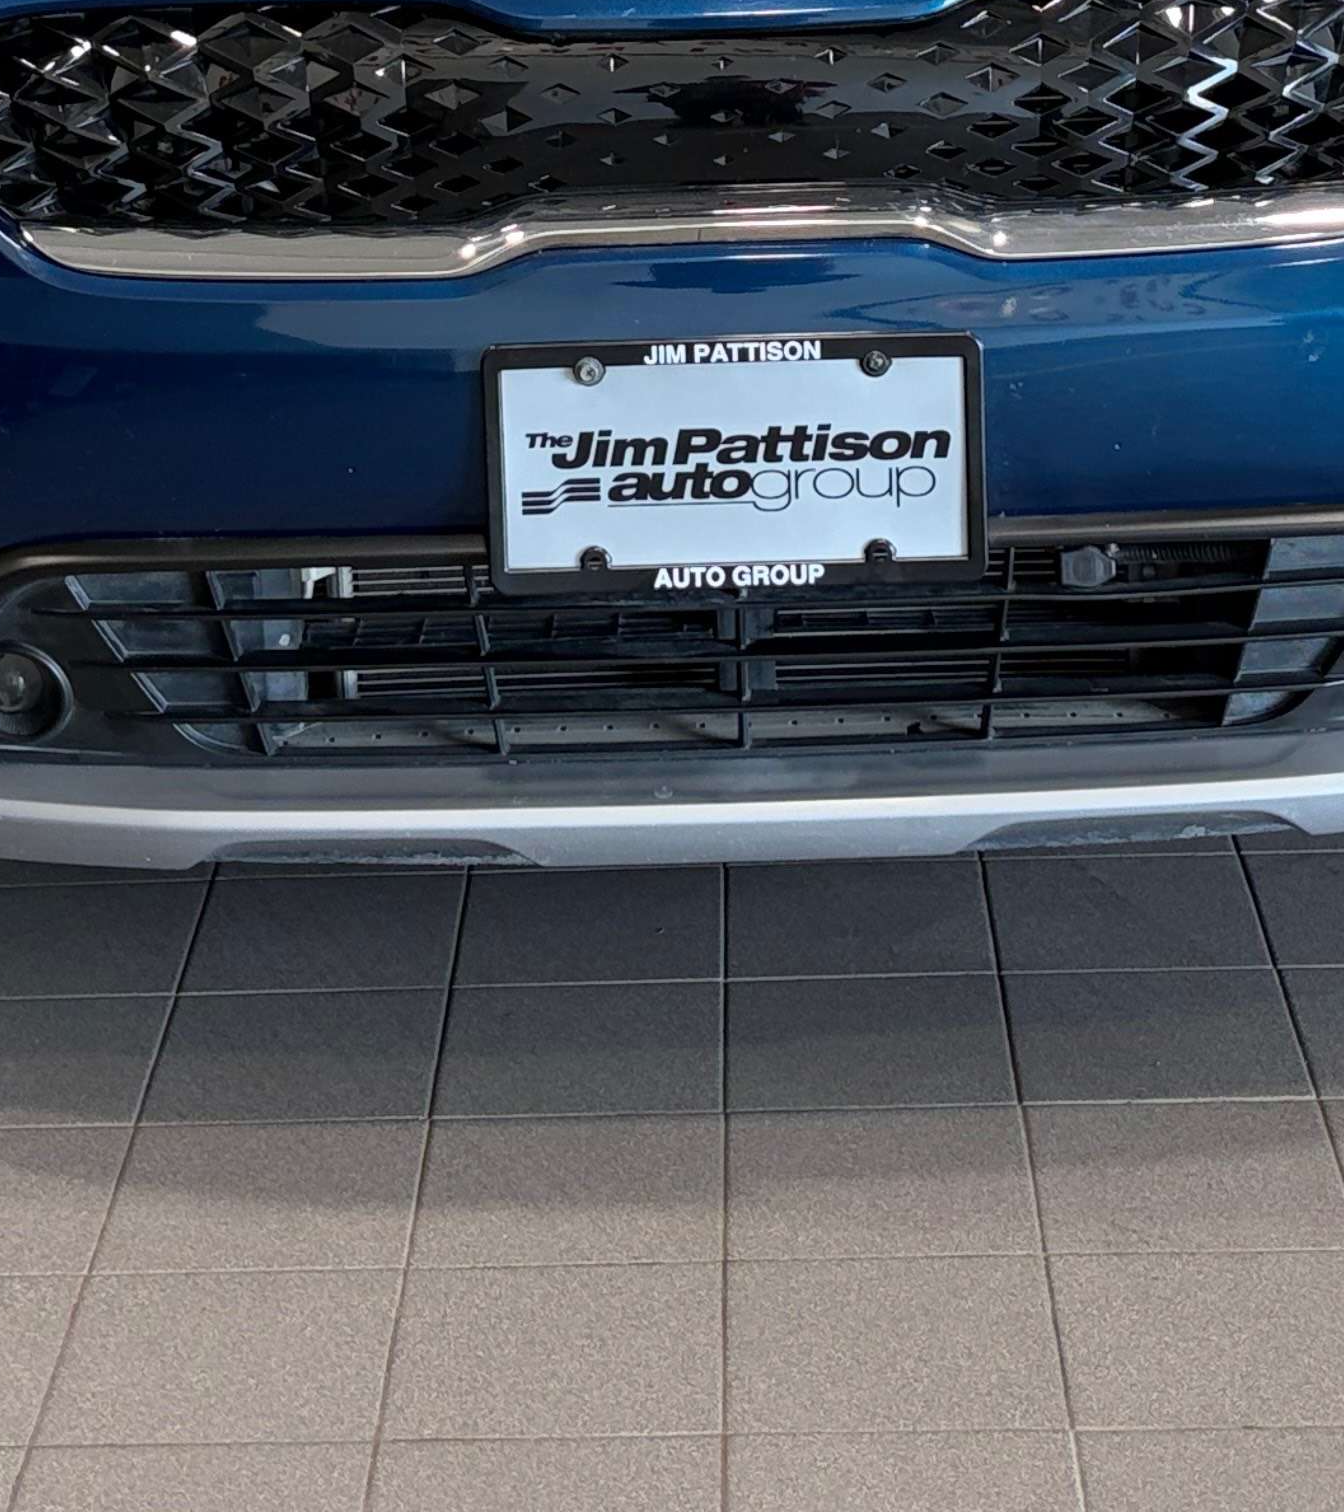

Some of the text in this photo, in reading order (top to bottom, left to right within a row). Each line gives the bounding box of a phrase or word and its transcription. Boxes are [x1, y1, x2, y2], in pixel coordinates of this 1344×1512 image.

[643, 340, 822, 365] JIM PATTISON
[525, 432, 574, 449] The
[654, 563, 825, 589] AUTO GROUP
